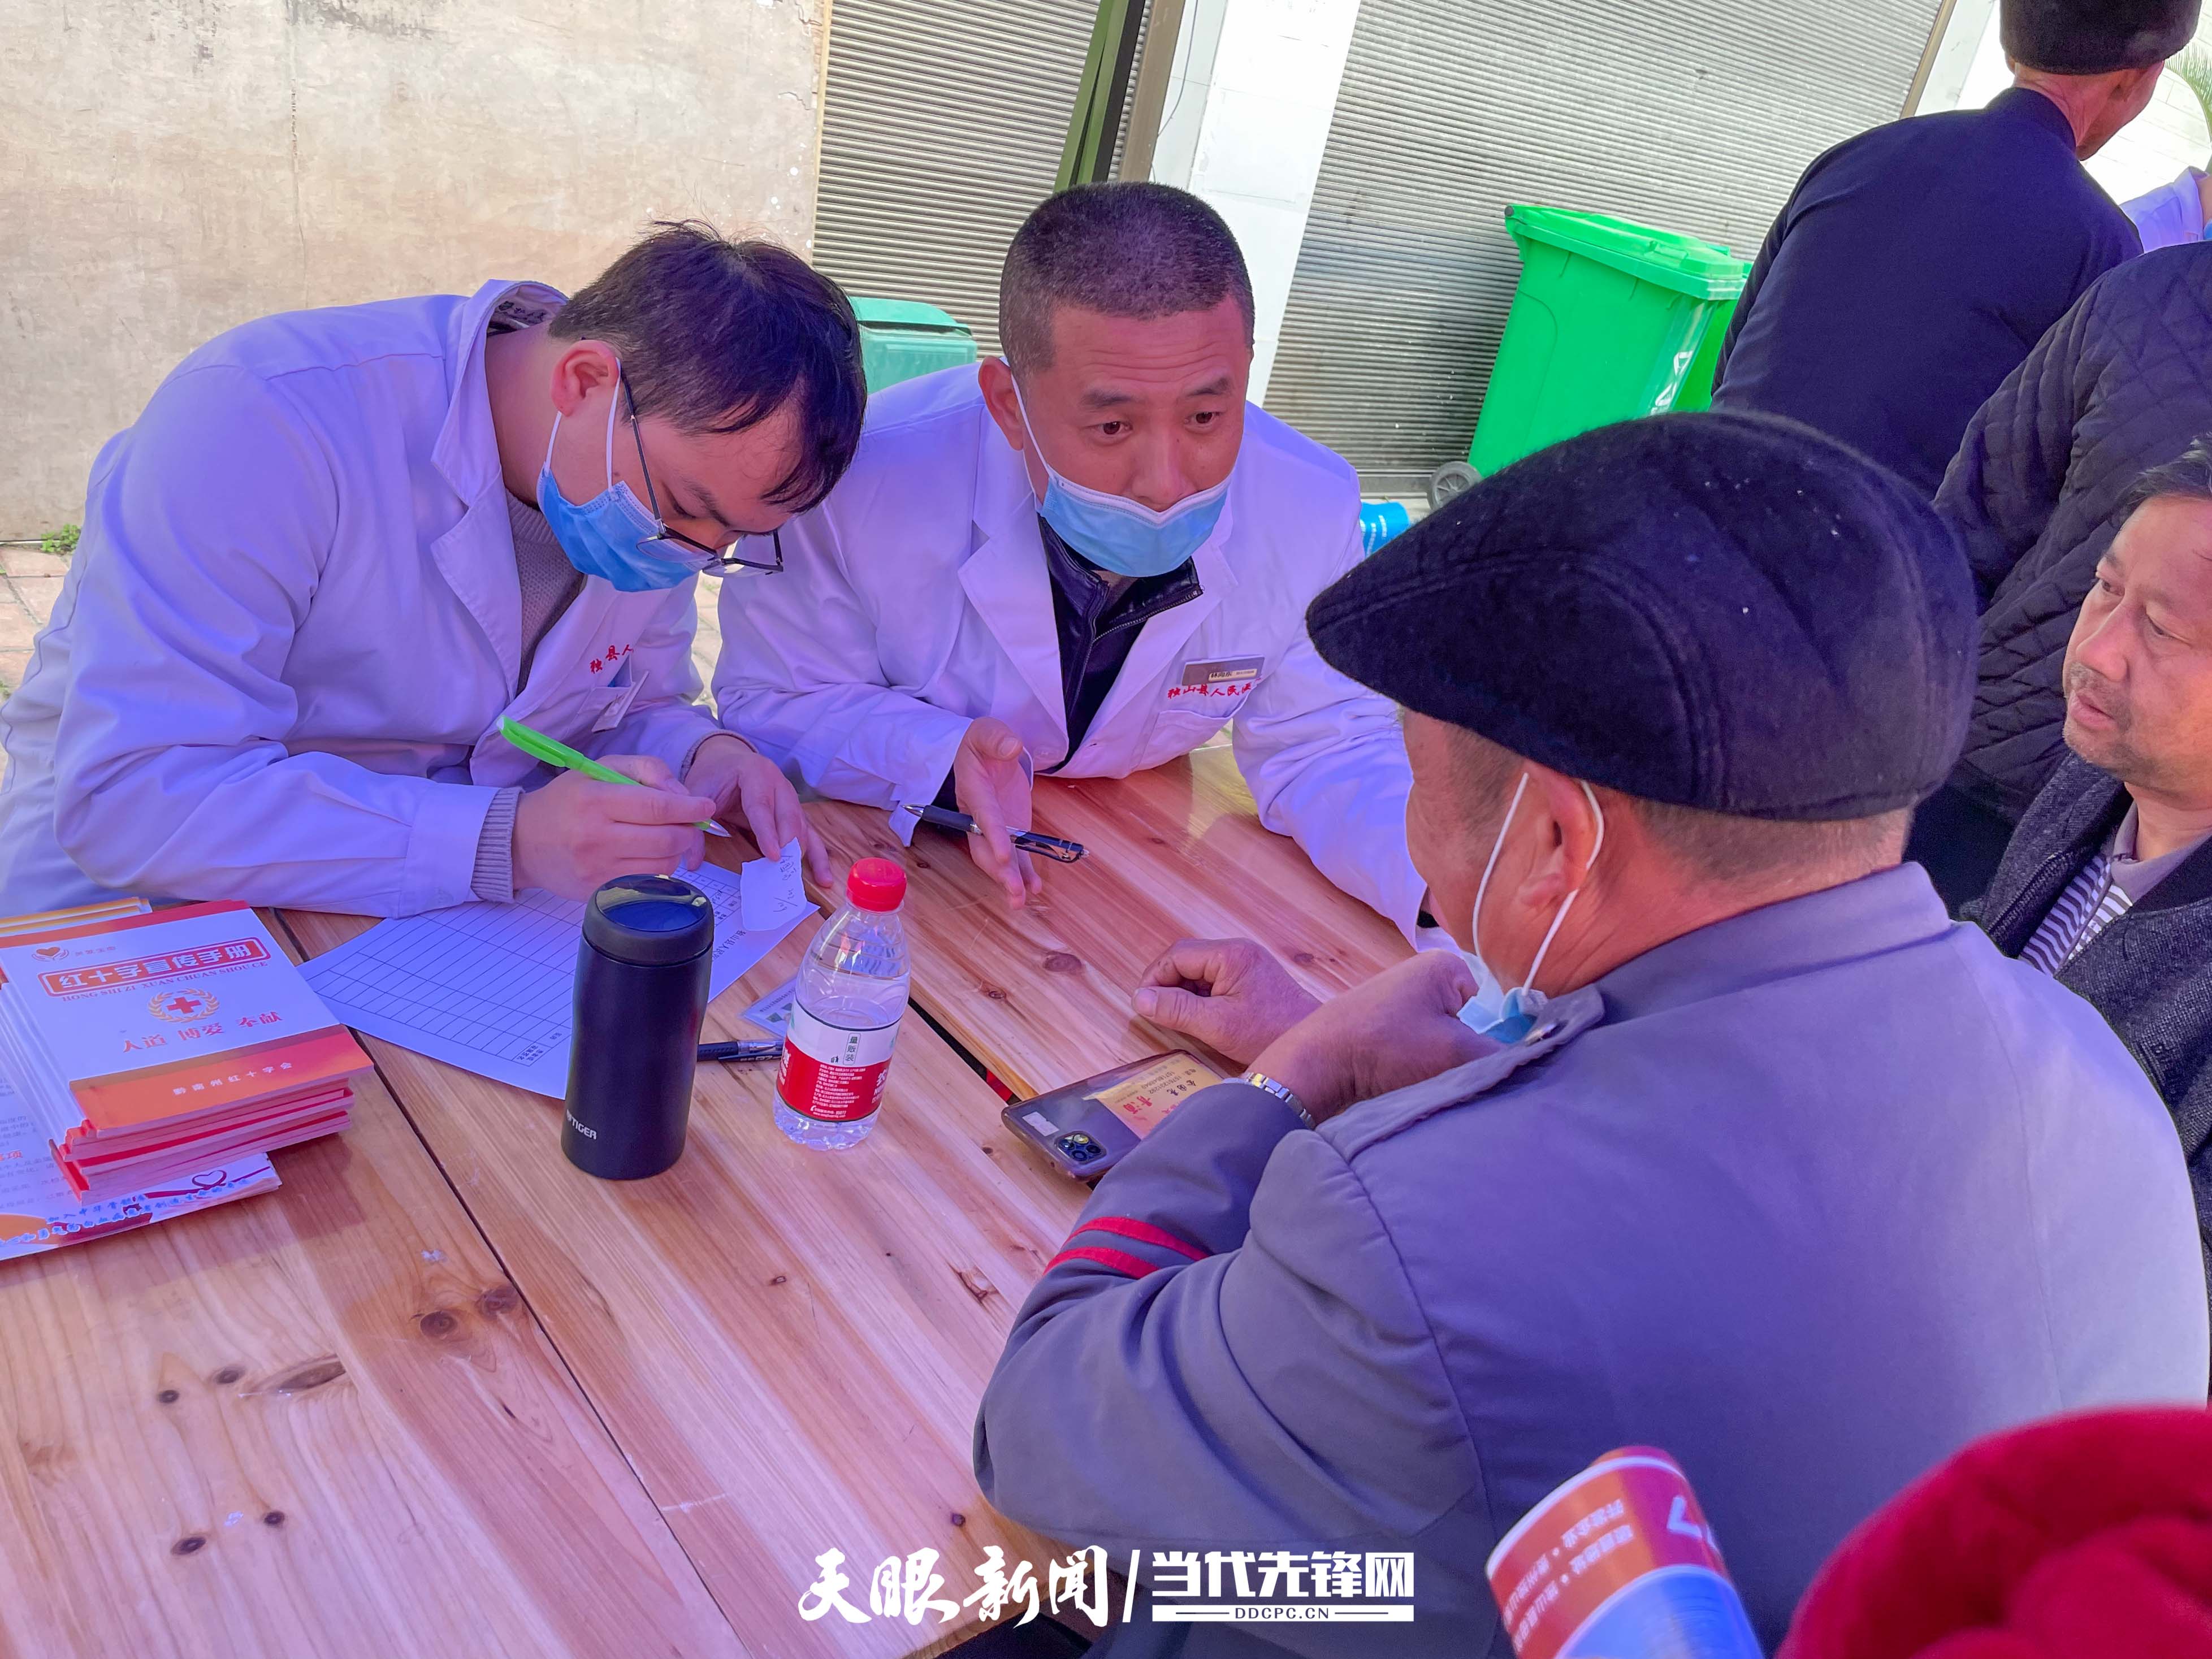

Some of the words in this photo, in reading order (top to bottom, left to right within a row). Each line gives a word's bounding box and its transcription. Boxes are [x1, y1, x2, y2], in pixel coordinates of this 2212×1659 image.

[1167, 678, 1262, 699] 独山县人民医
[59, 944, 252, 989] 红十字宣传手册
[62, 991, 98, 1002] HONG
[101, 987, 122, 996] SHI
[142, 978, 174, 989] XUAN
[176, 971, 219, 982] CHUAN
[219, 964, 250, 974] SHOU
[252, 960, 268, 969] CE
[123, 1034, 167, 1053] 人道
[177, 1022, 224, 1041] 博爱
[236, 1011, 283, 1028] 奉献
[845, 1035, 858, 1062] 量贩装
[173, 1062, 293, 1095] 黔南州红十字会
[571, 1115, 597, 1140] TIGER
